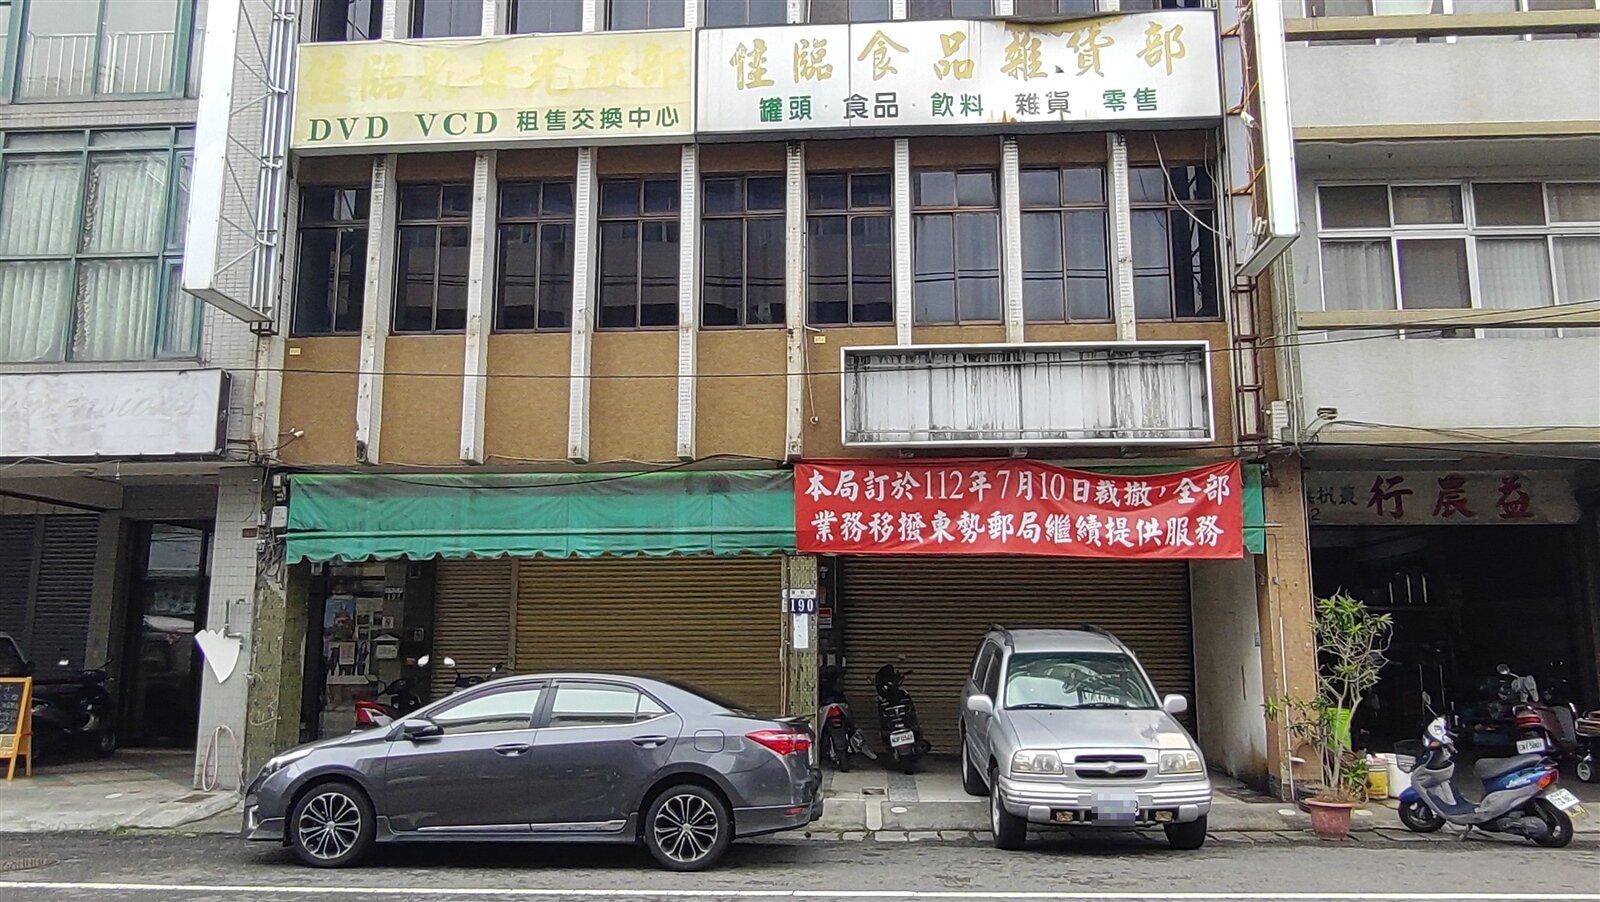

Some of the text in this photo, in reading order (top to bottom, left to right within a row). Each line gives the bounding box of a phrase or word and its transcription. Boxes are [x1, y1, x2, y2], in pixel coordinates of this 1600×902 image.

[759, 87, 1158, 123] 罐頭 食品 飲料 雜貨 零售
[308, 105, 680, 142] DVD VCD 租售交換中心
[811, 509, 1225, 548] 業務移撥東勢郵局繼續提供服務
[790, 598, 814, 613] 190
